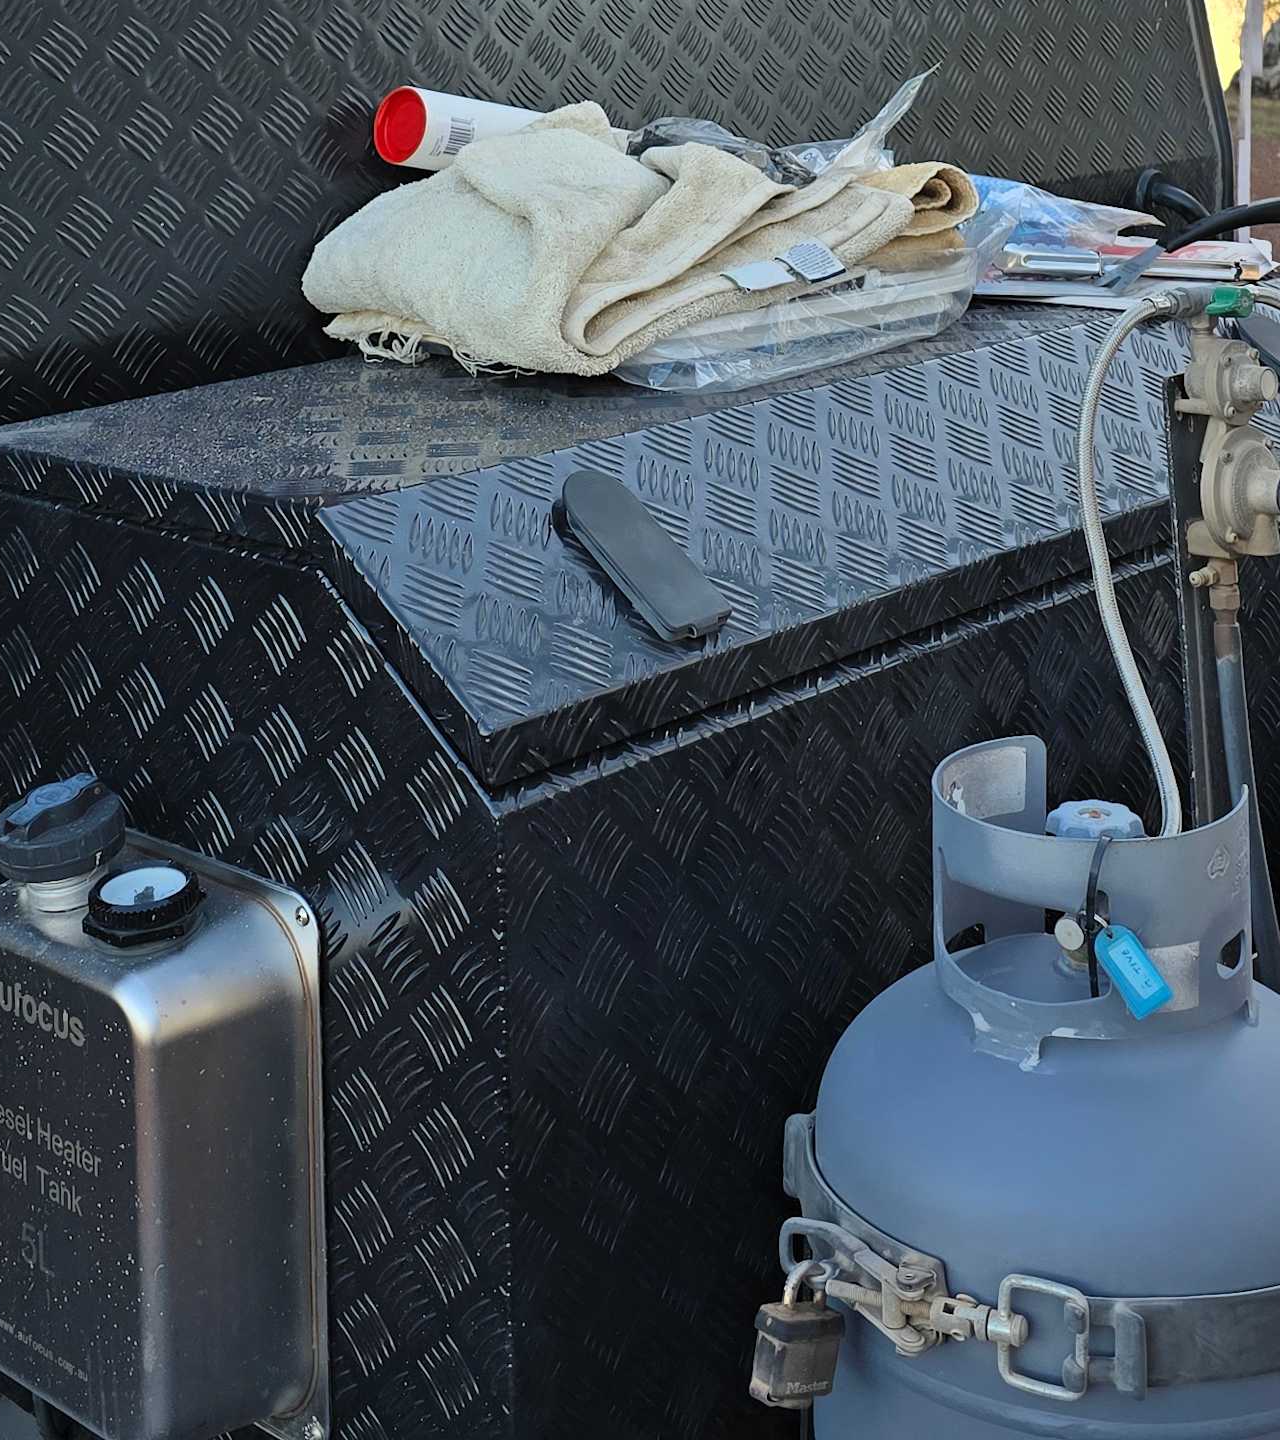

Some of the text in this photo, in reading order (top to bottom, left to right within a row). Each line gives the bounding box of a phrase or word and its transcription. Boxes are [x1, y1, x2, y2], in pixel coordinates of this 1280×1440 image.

[36, 1116, 102, 1177] Heater
[36, 1164, 82, 1216] Tank
[21, 1221, 56, 1278] 5L
[785, 1380, 829, 1394] Master
